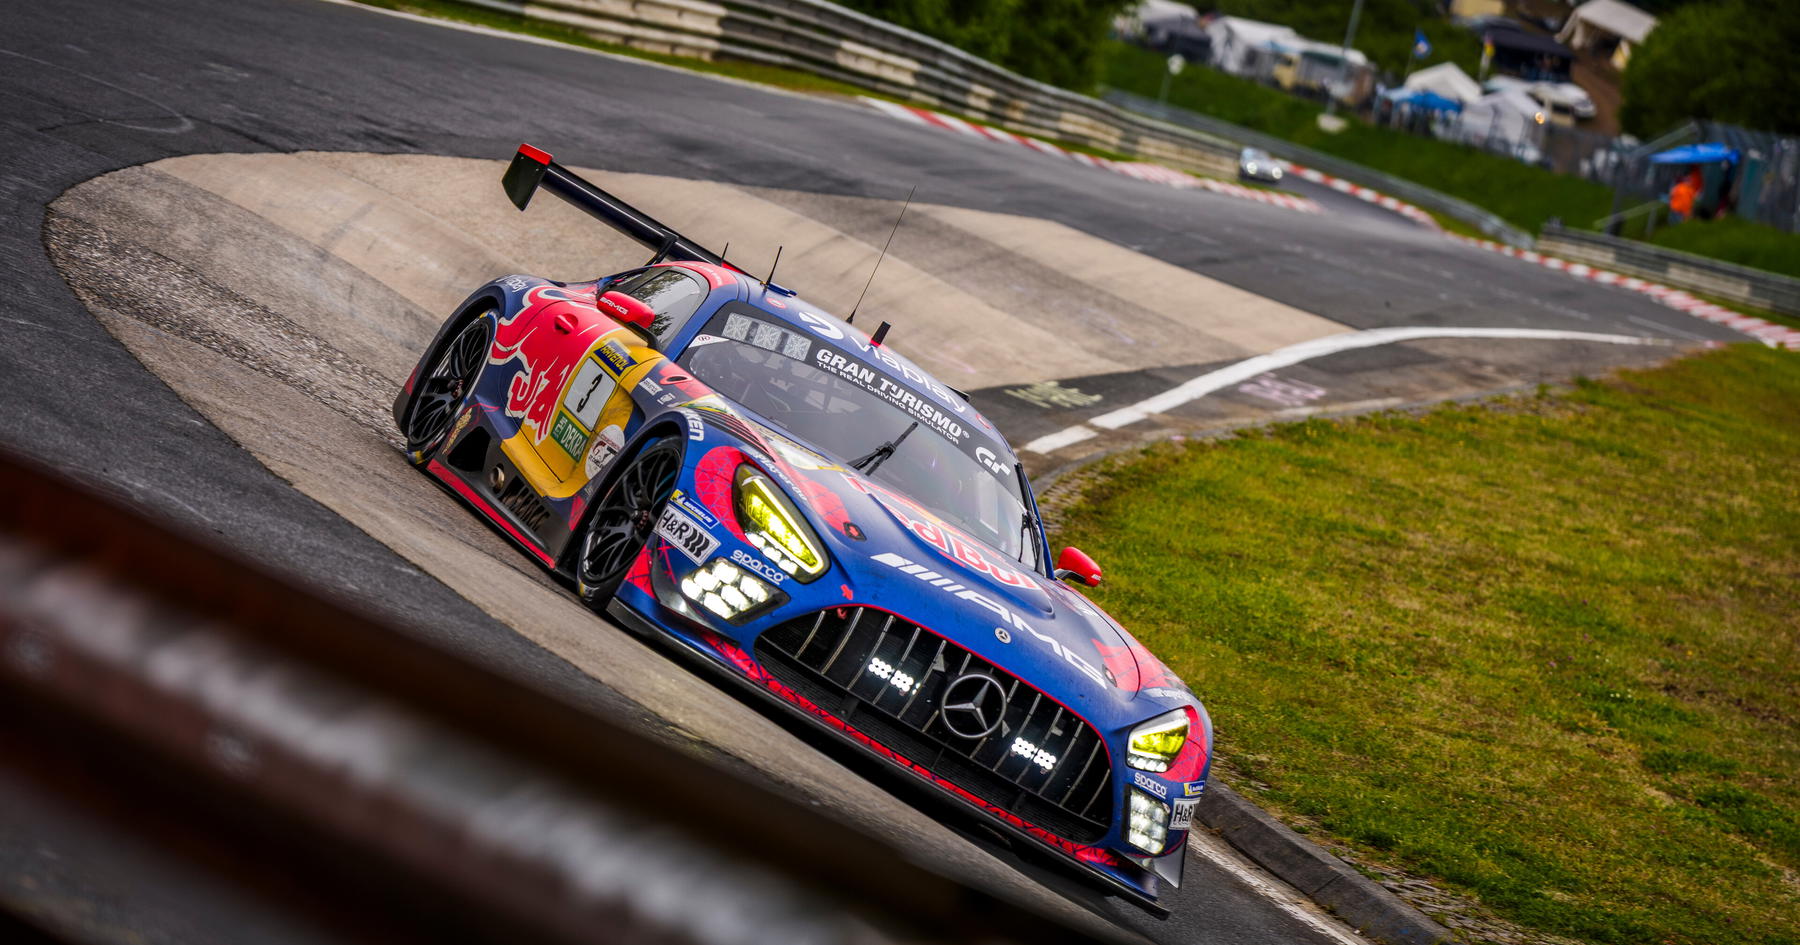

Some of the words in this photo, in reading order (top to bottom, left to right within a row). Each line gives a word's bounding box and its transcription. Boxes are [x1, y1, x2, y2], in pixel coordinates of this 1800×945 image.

[816, 348, 875, 384] GRAN
[850, 335, 966, 413] viaplay
[576, 373, 604, 413] 3
[816, 360, 838, 374] THE
[839, 371, 866, 388] REAL
[867, 384, 906, 410] DRIVING
[907, 407, 960, 445] SIMULATOR
[560, 423, 588, 461] DEKRA
[660, 509, 691, 540] H&R
[731, 548, 784, 583] sparco
[953, 589, 1108, 690] AMG
[1134, 772, 1167, 796] sparco
[1173, 803, 1193, 823] H&R
